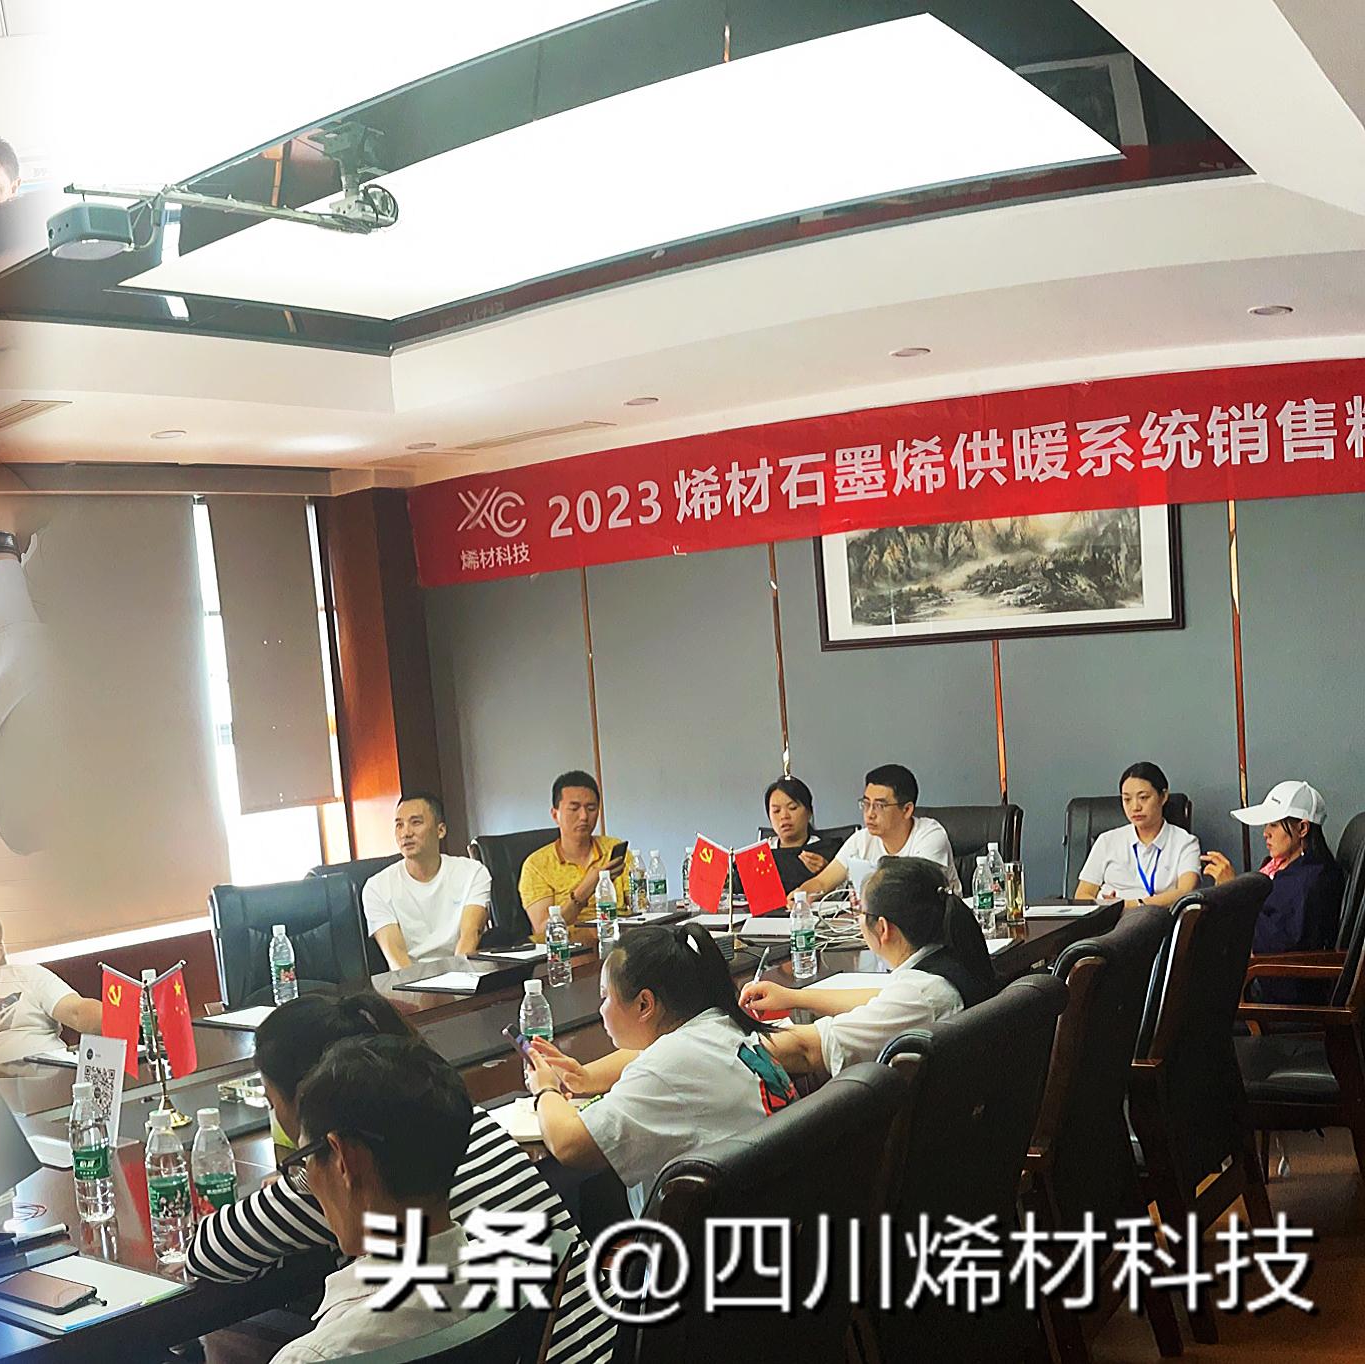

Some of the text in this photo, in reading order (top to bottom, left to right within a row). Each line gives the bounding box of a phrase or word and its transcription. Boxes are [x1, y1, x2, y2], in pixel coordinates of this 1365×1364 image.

[548, 480, 662, 538] 2023
[460, 542, 531, 571] 烯材科技
